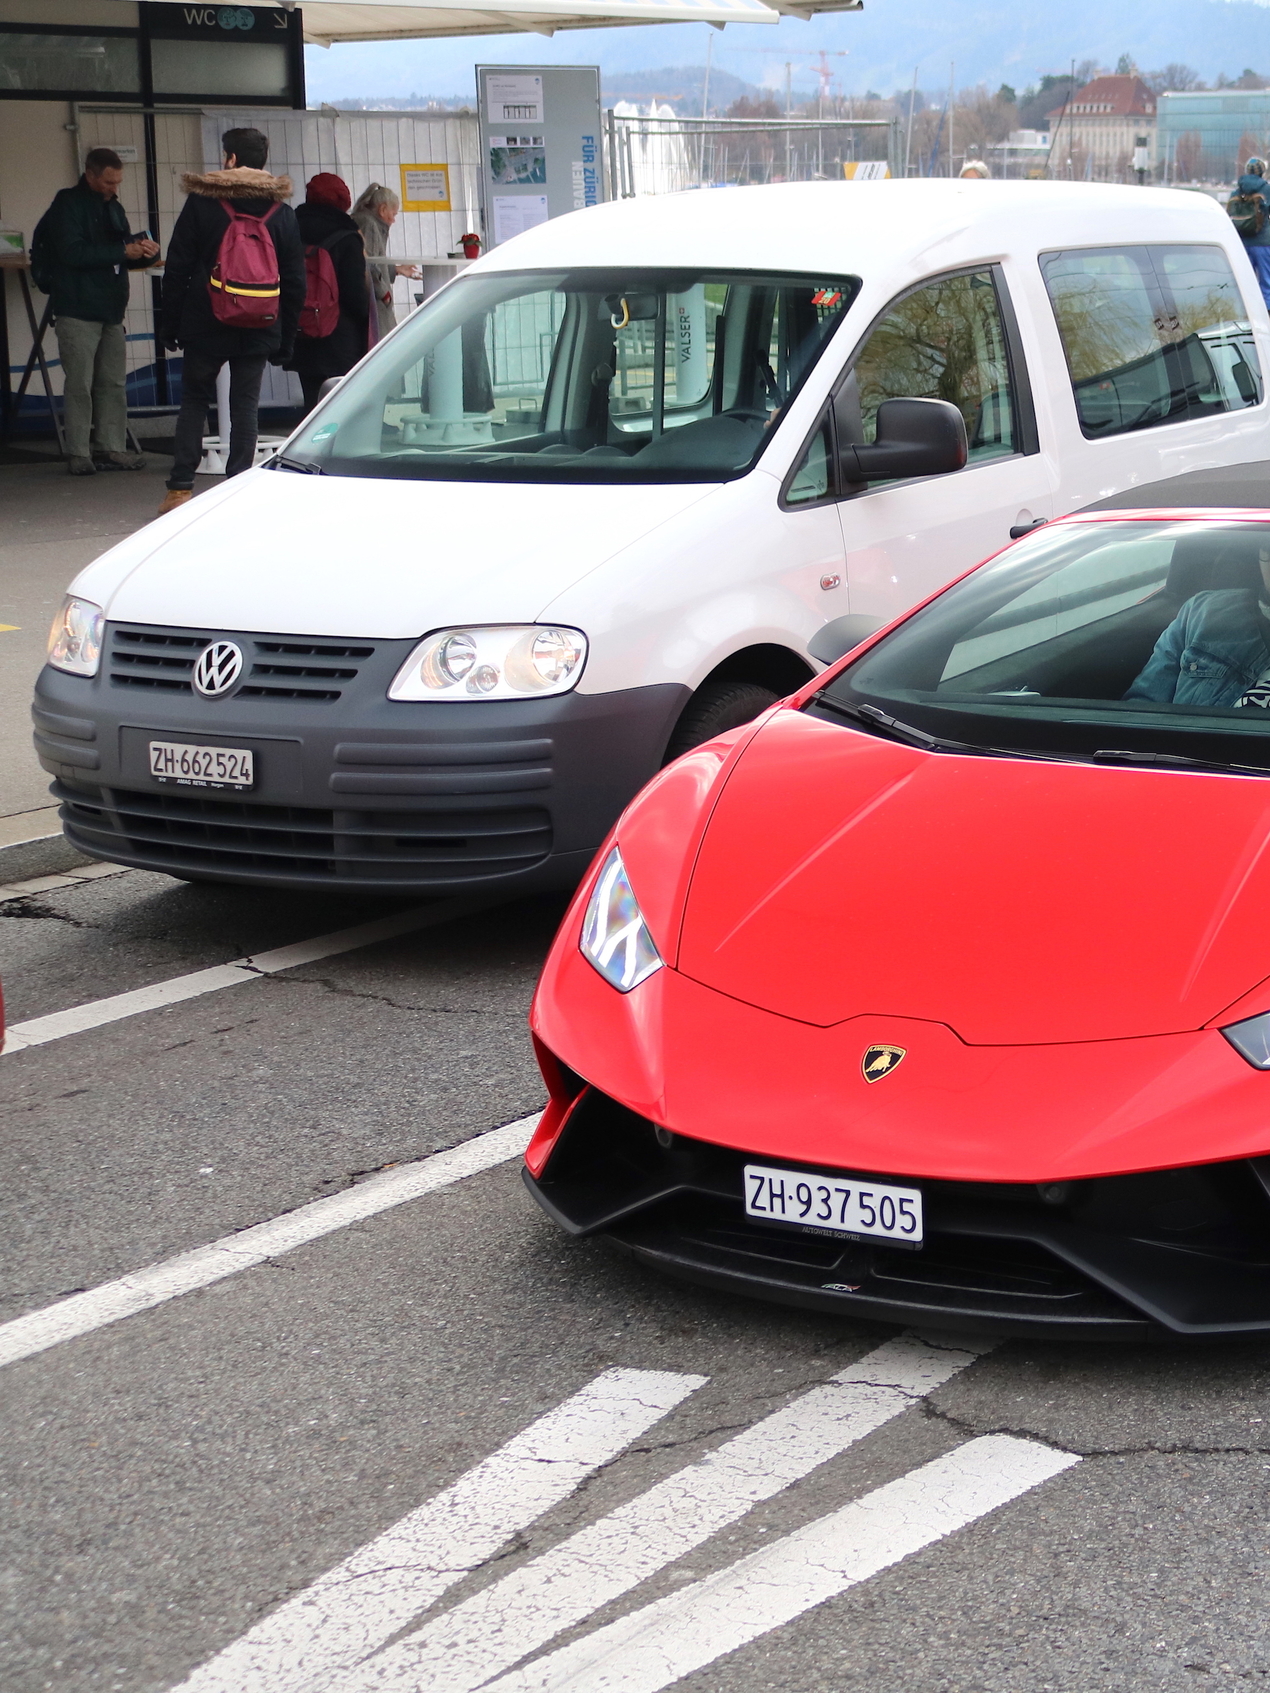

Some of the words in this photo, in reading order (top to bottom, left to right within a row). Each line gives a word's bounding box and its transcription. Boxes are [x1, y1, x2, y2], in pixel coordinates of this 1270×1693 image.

[184, 8, 216, 26] WC
[582, 135, 598, 163] FÜR
[572, 161, 586, 209] BAUEN
[680, 315, 691, 363] VALSER
[801, 1226, 833, 1237] AUTOWELT
[834, 1230, 861, 1241] SCHWEIZ
